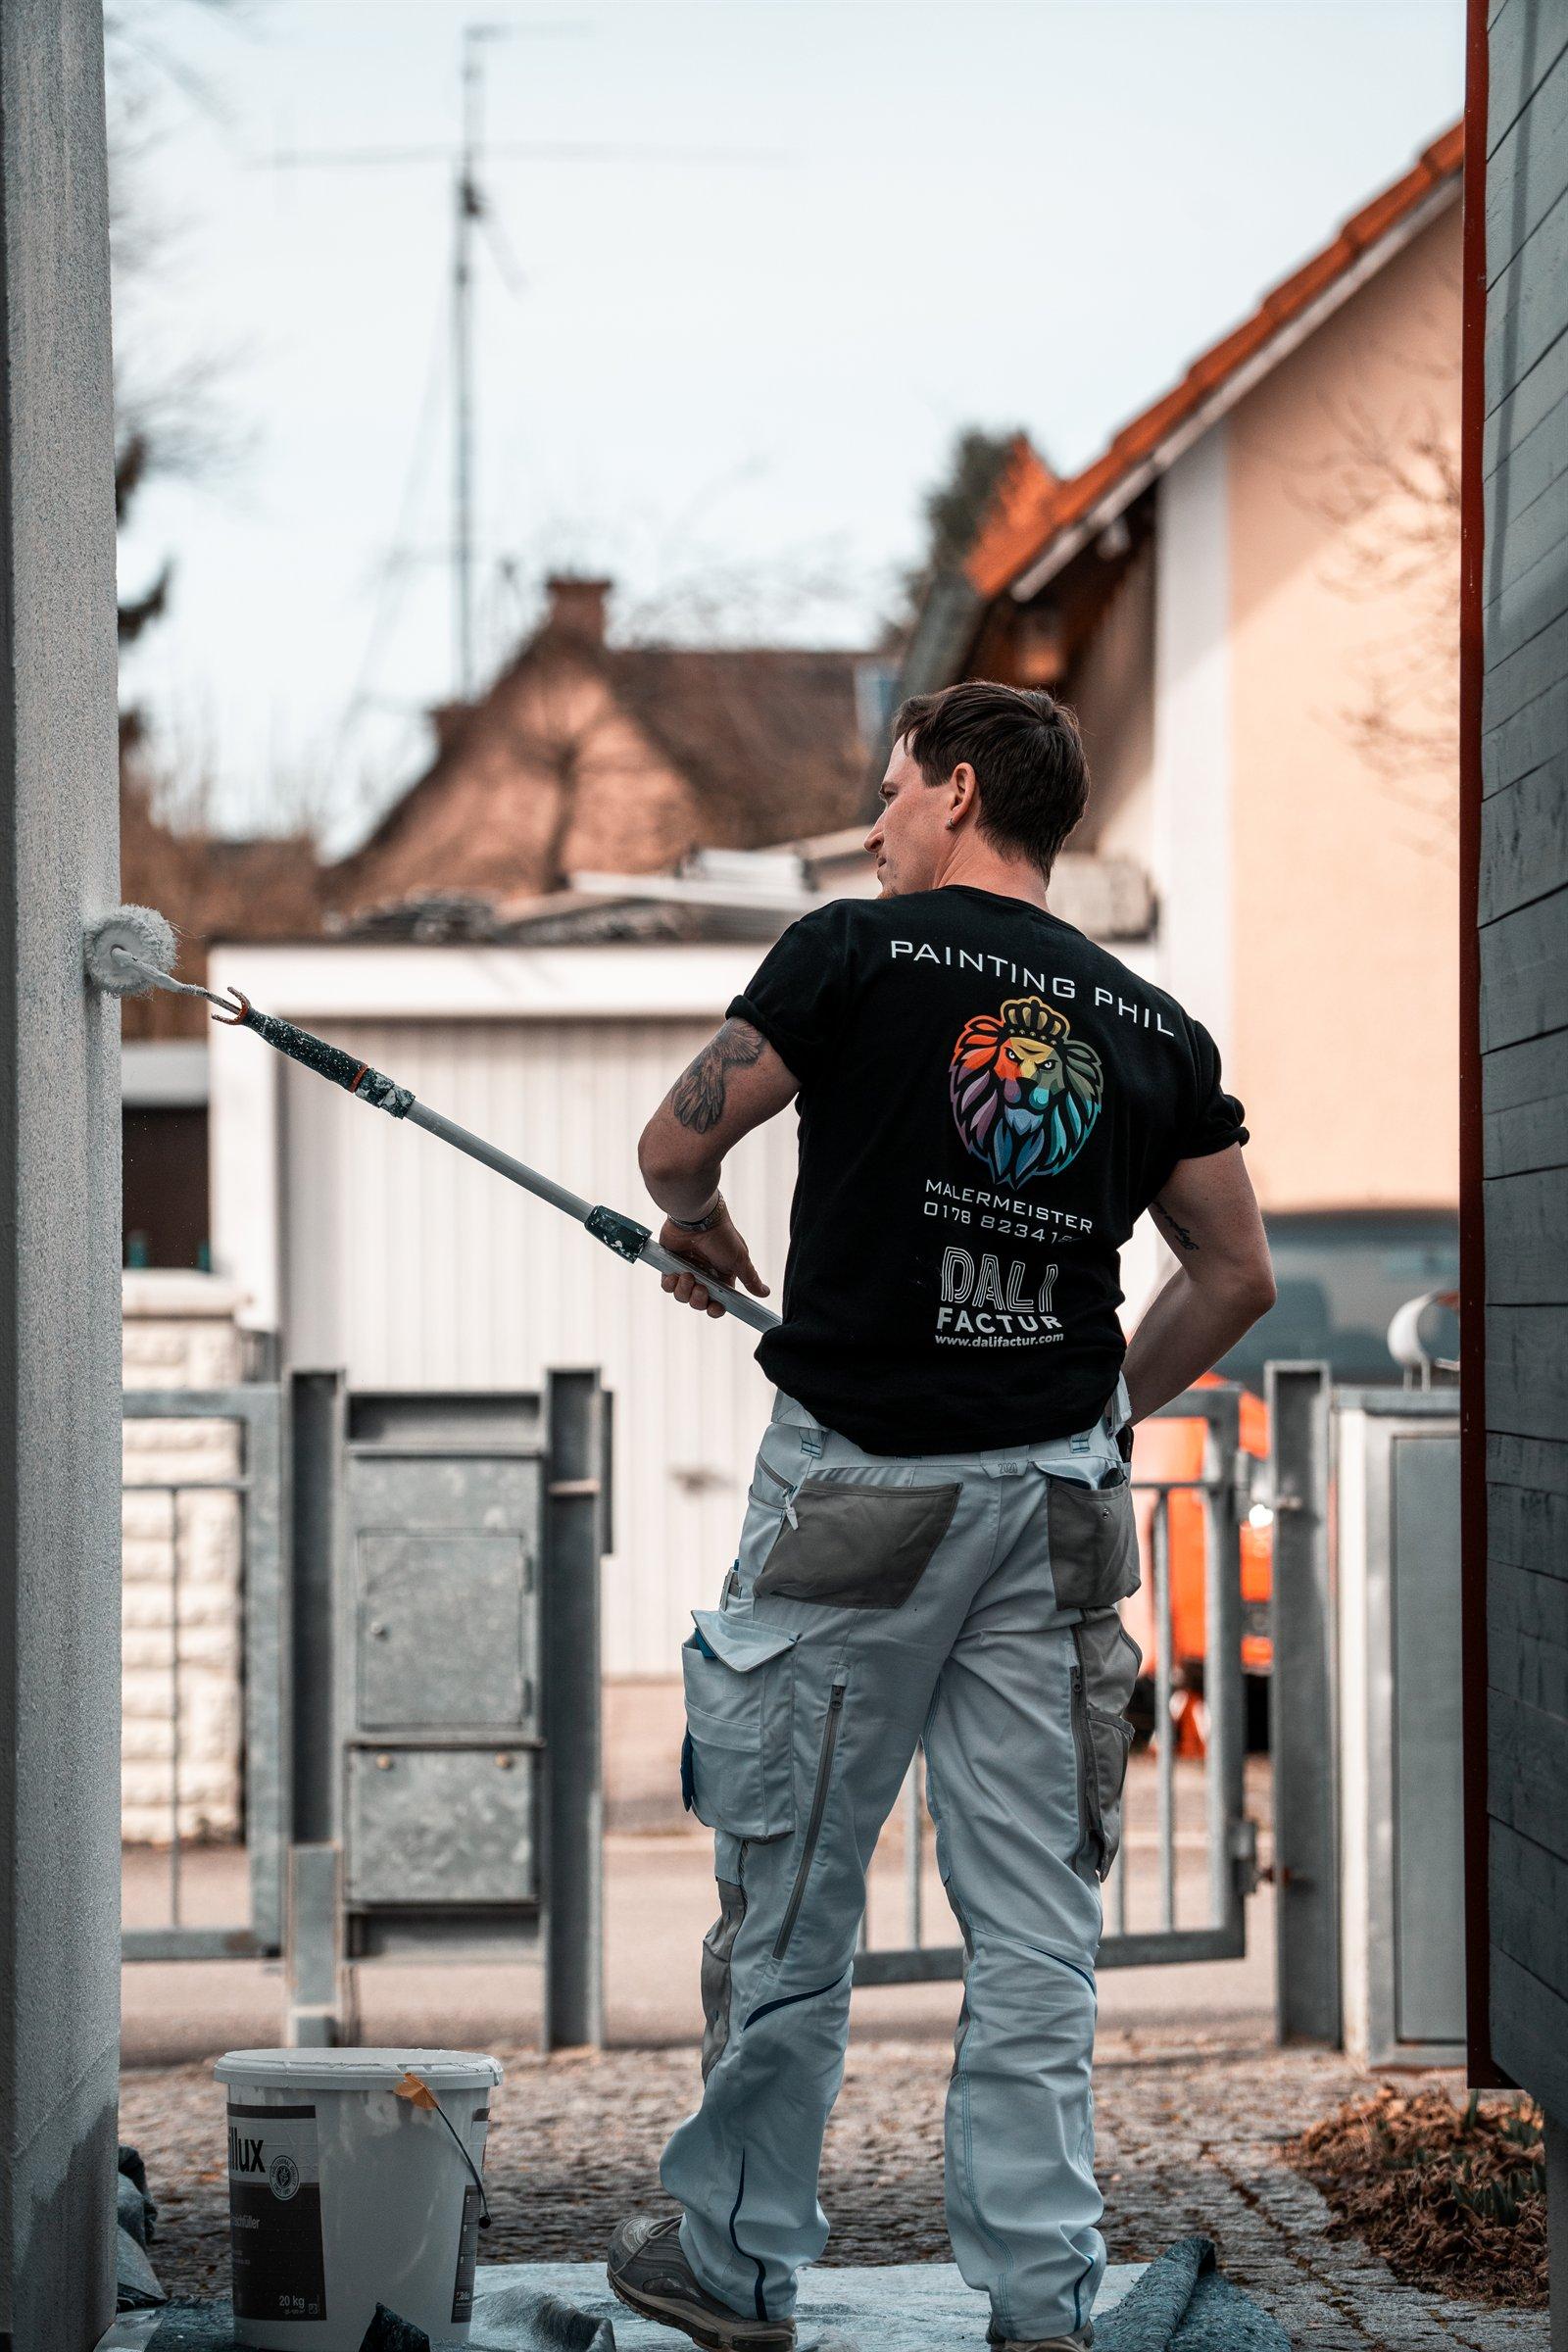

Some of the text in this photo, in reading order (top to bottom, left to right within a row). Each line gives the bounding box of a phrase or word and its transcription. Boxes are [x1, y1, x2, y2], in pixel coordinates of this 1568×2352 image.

[891, 941, 1175, 1037] PAINTING PHIL
[924, 1201, 971, 1225] 0178
[925, 1179, 1093, 1234] MALERMEISTER
[941, 1247, 1058, 1313] DALI
[936, 1306, 1062, 1334] FACTUR
[935, 1333, 1064, 1348] www.dalifactur.com
[279, 2295, 305, 2310] 20 kg
